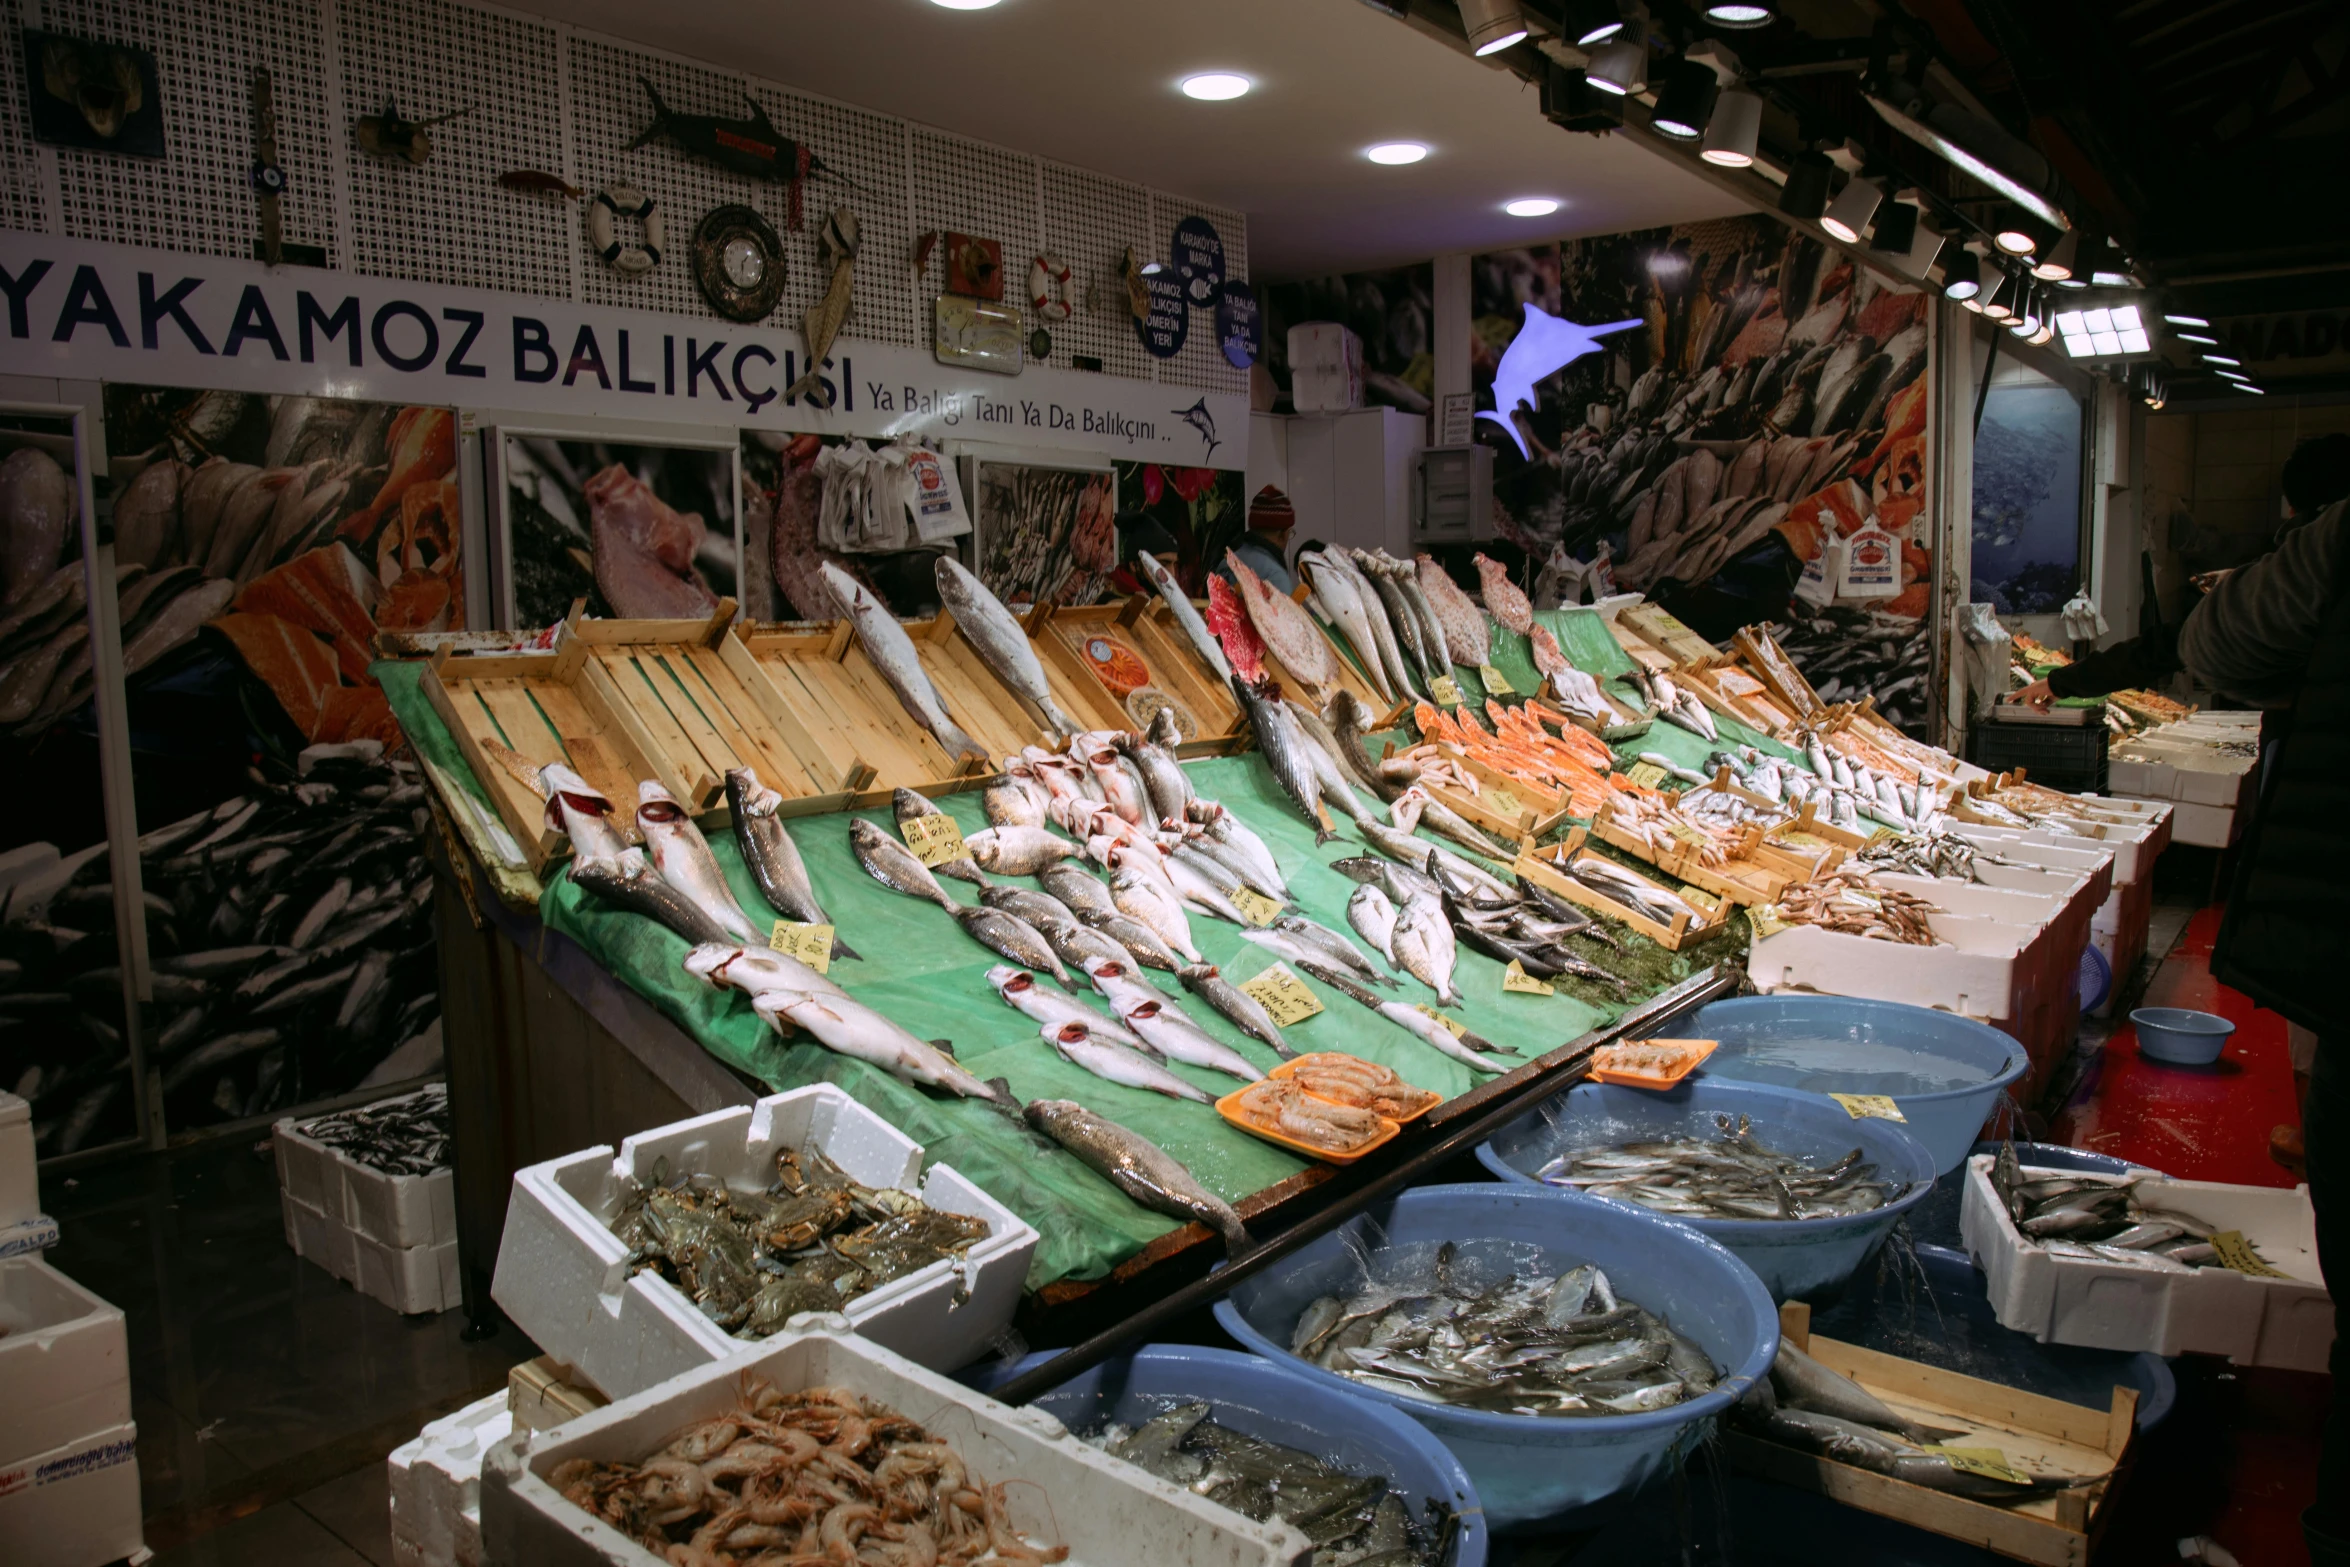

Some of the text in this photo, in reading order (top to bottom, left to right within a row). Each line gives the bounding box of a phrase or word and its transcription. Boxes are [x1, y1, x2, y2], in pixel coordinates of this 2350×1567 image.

[1189, 250, 1212, 268] MARKA
[1150, 296, 1181, 315] LIKÇISI
[0, 259, 486, 378] YAKAMOZ
[512, 315, 854, 414] BALIKÇISI
[1241, 326, 1250, 337] DA
[867, 381, 895, 411] Ya
[904, 386, 964, 426] Balığı
[972, 395, 1014, 424] Tanı
[1020, 400, 1042, 427] Ya
[1049, 404, 1076, 430] Da
[1083, 408, 1156, 444] Balıkçını
